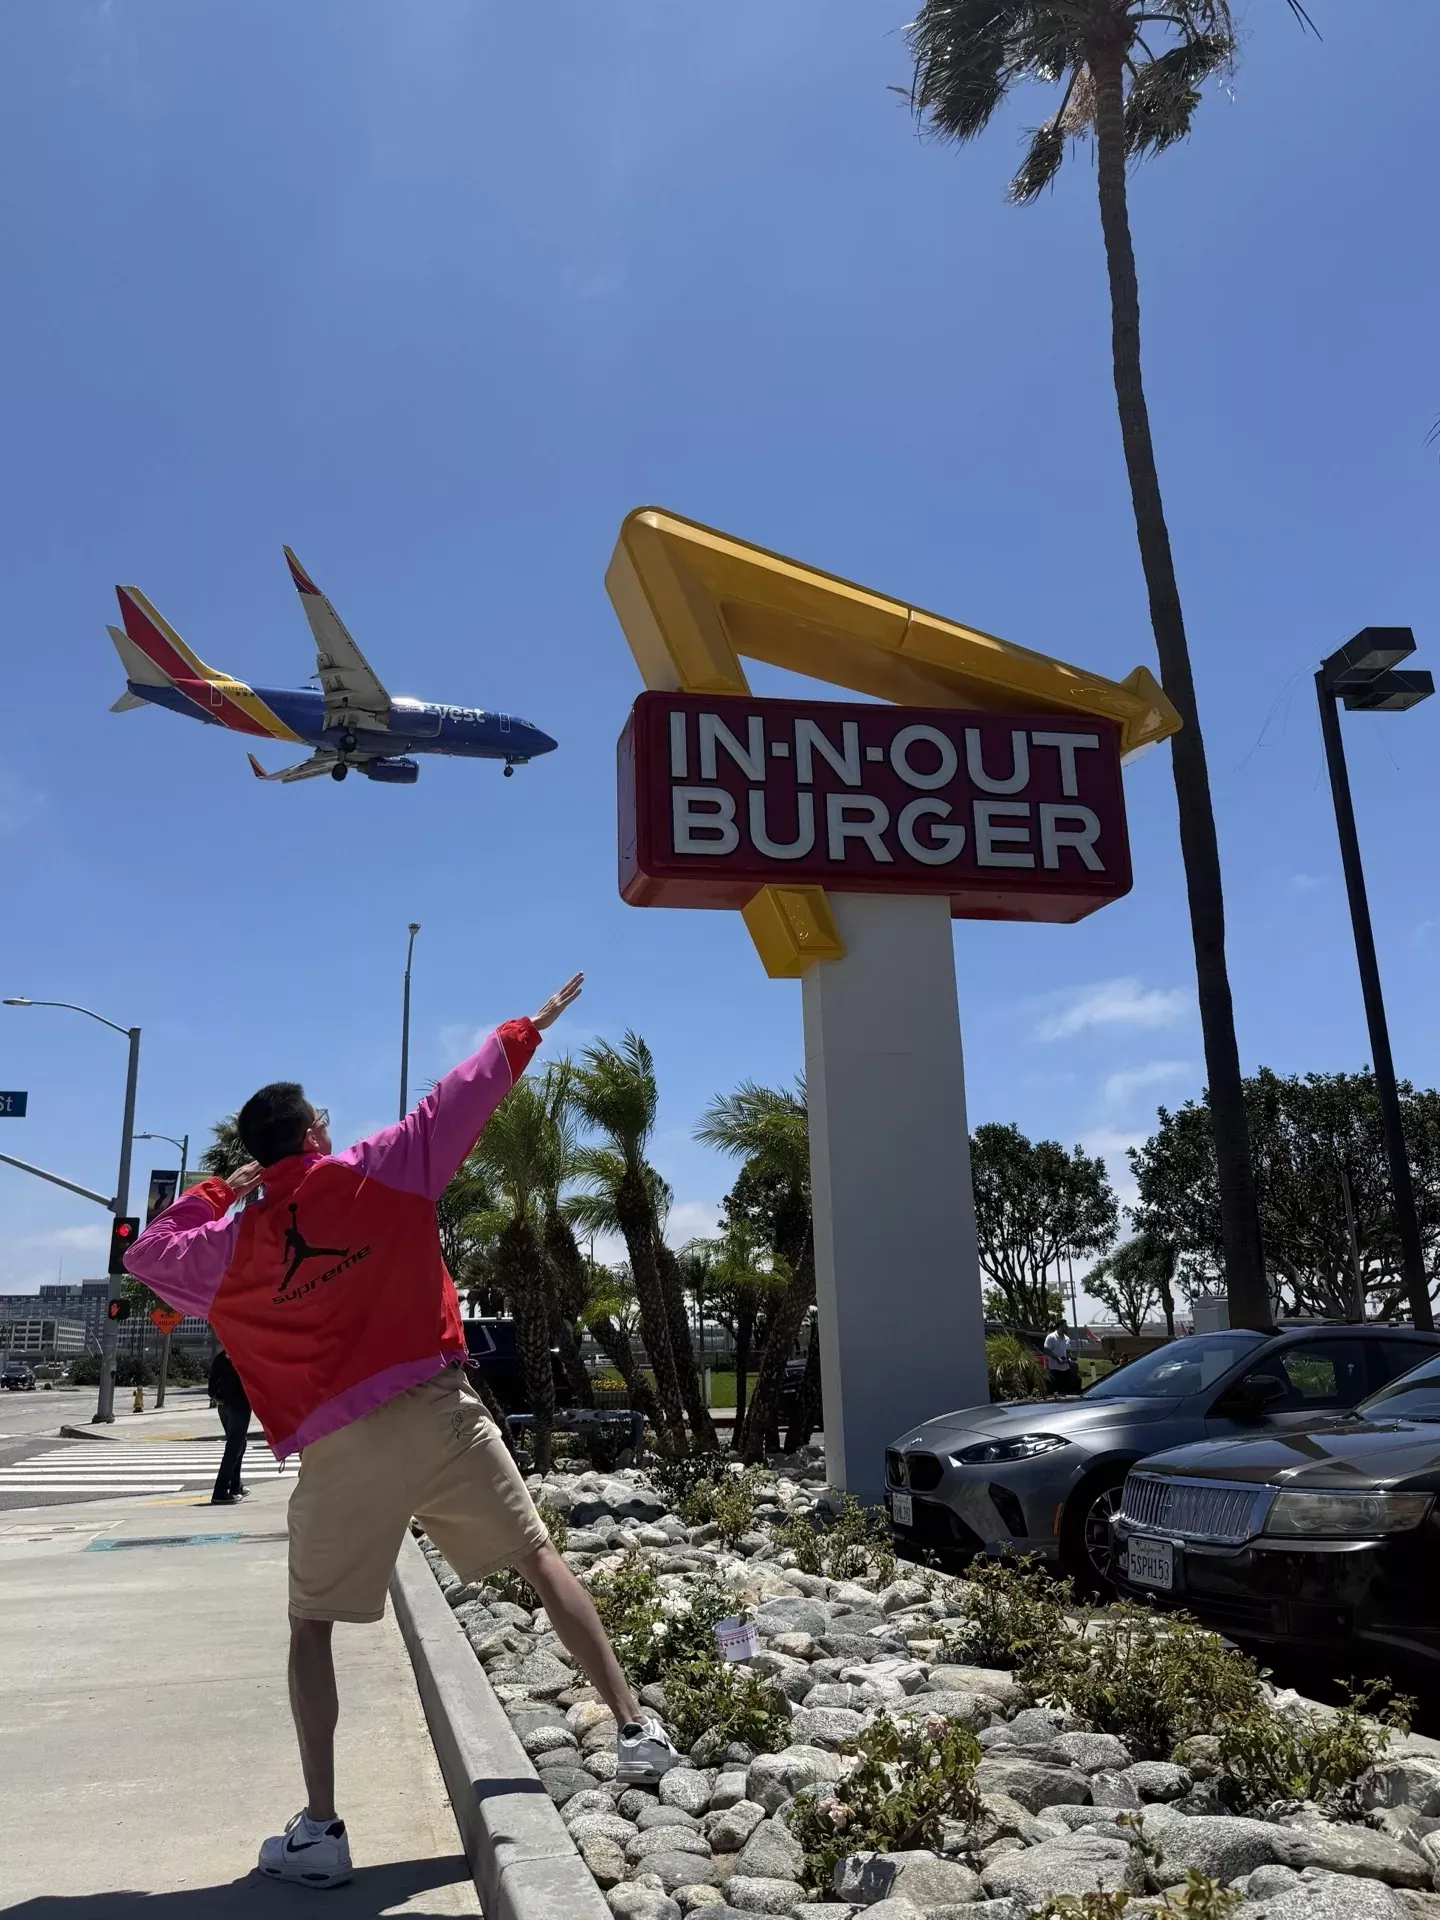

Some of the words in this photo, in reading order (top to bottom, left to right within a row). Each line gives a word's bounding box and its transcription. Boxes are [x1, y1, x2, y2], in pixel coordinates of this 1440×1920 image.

[669, 711, 1100, 797] IN-N-OUT
[671, 785, 1106, 871] BURGER
[272, 1245, 370, 1305] supreme
[1131, 1553, 1170, 1581] 5SPH153
